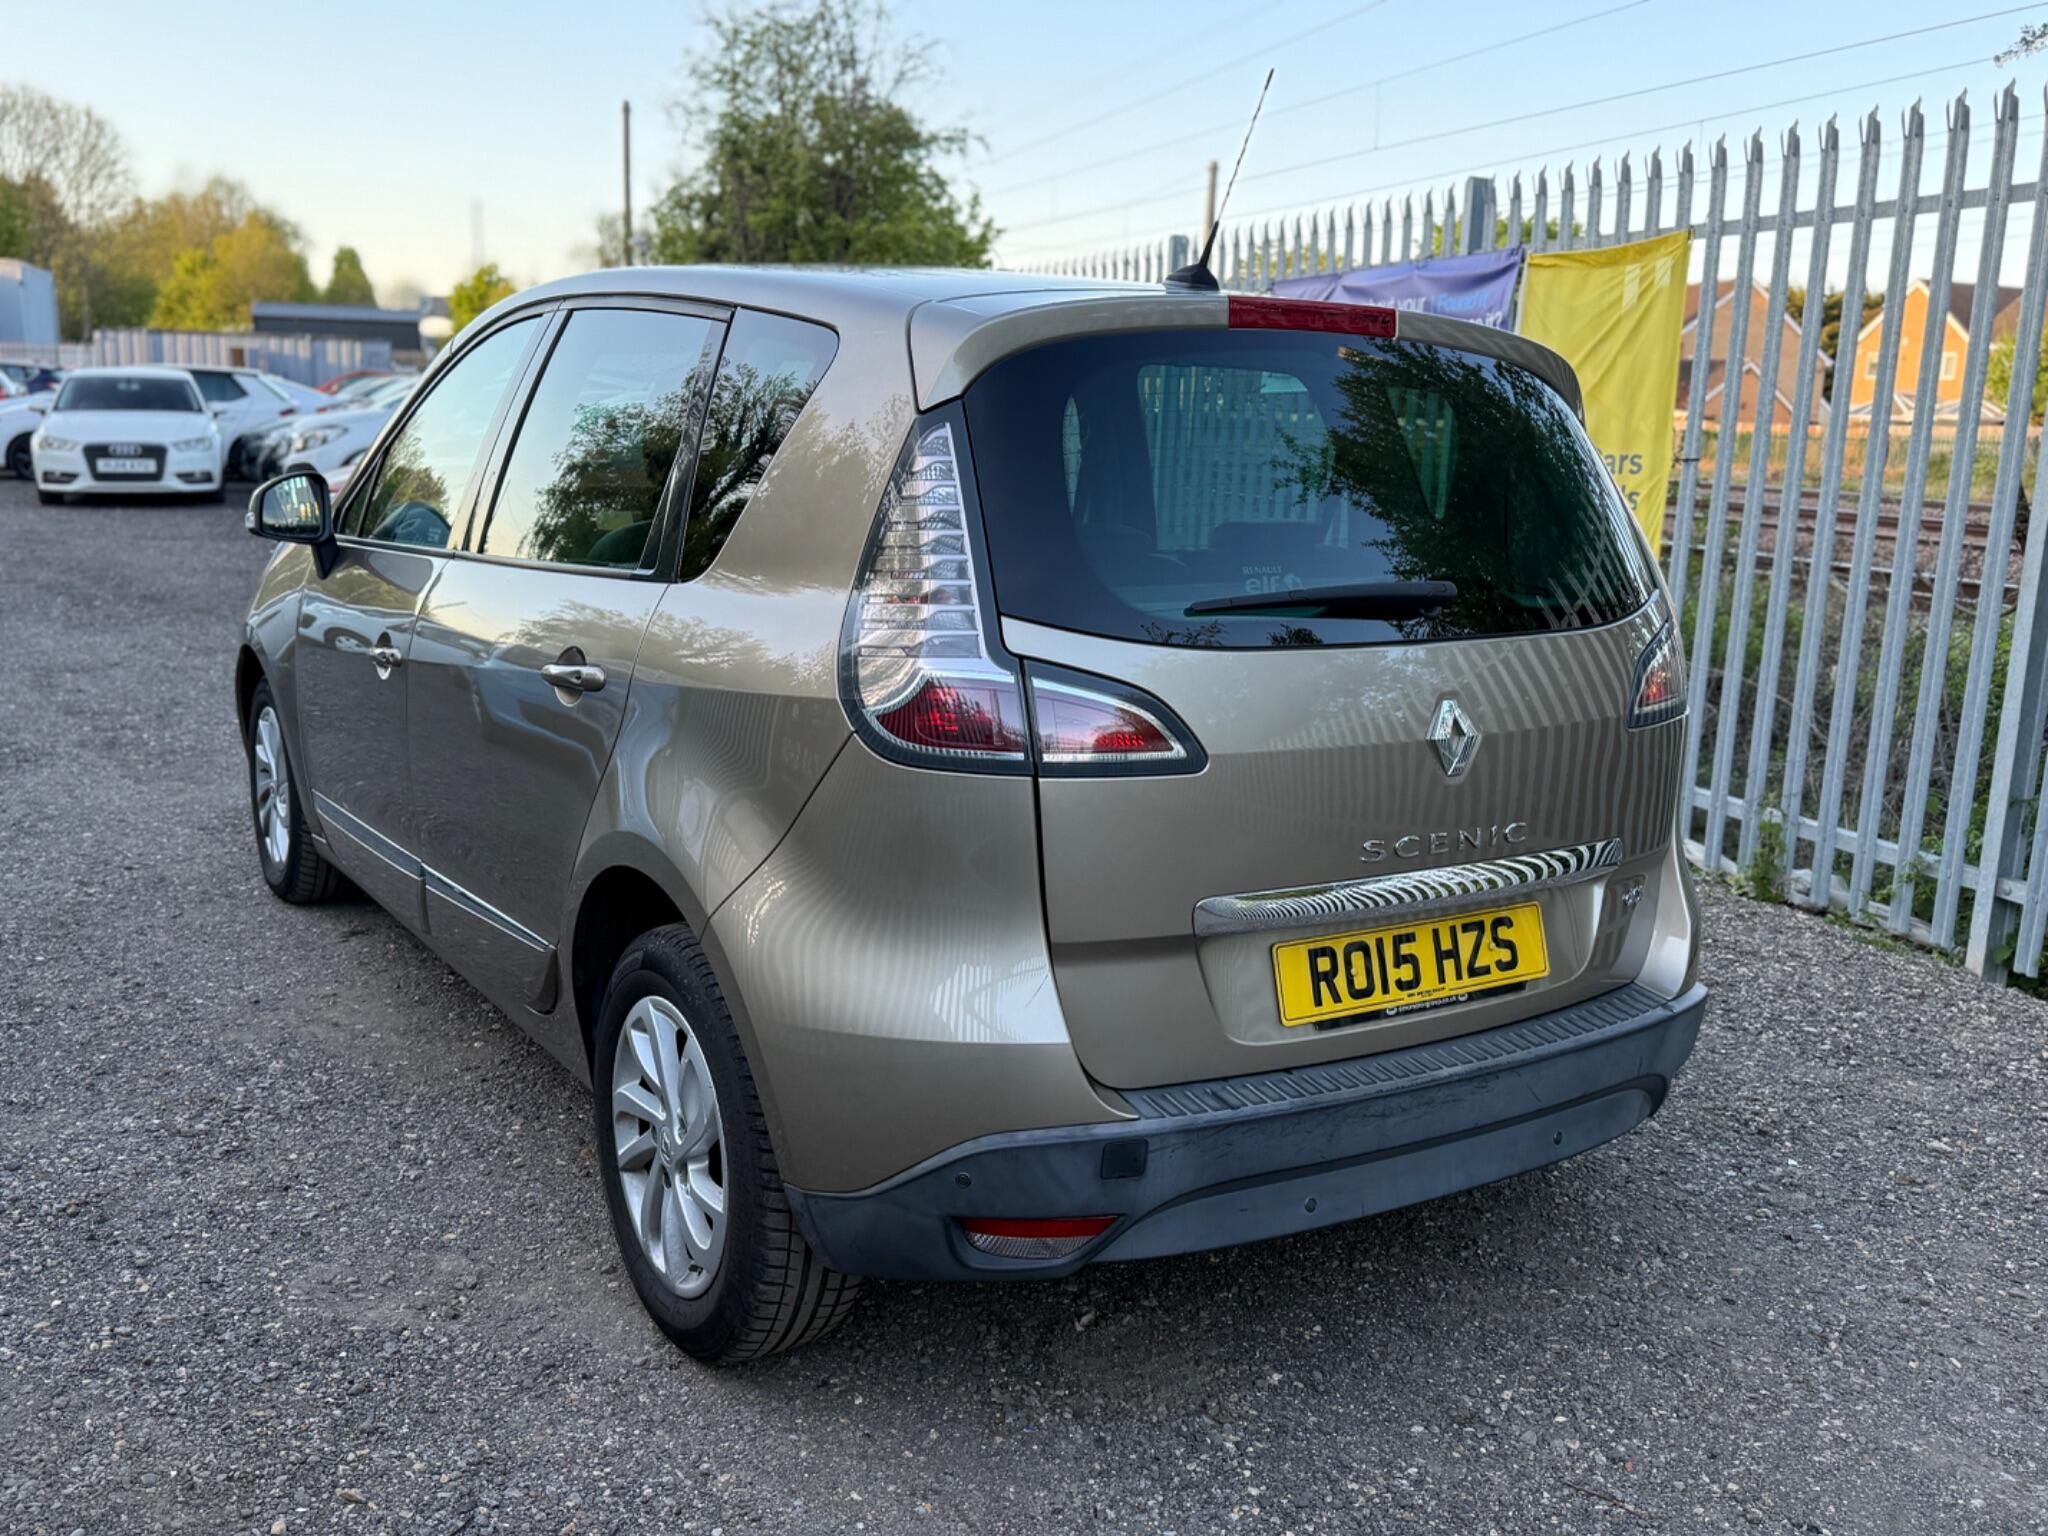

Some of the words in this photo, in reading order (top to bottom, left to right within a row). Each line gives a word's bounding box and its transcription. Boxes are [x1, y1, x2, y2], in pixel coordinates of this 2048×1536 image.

[1597, 448, 1643, 475] ars
[1241, 565, 1283, 576] RENAULT
[1245, 575, 1280, 594] elf
[1360, 822, 1528, 863] SCENIC
[1307, 932, 1422, 1008] RO15
[1432, 915, 1520, 985] HZS
